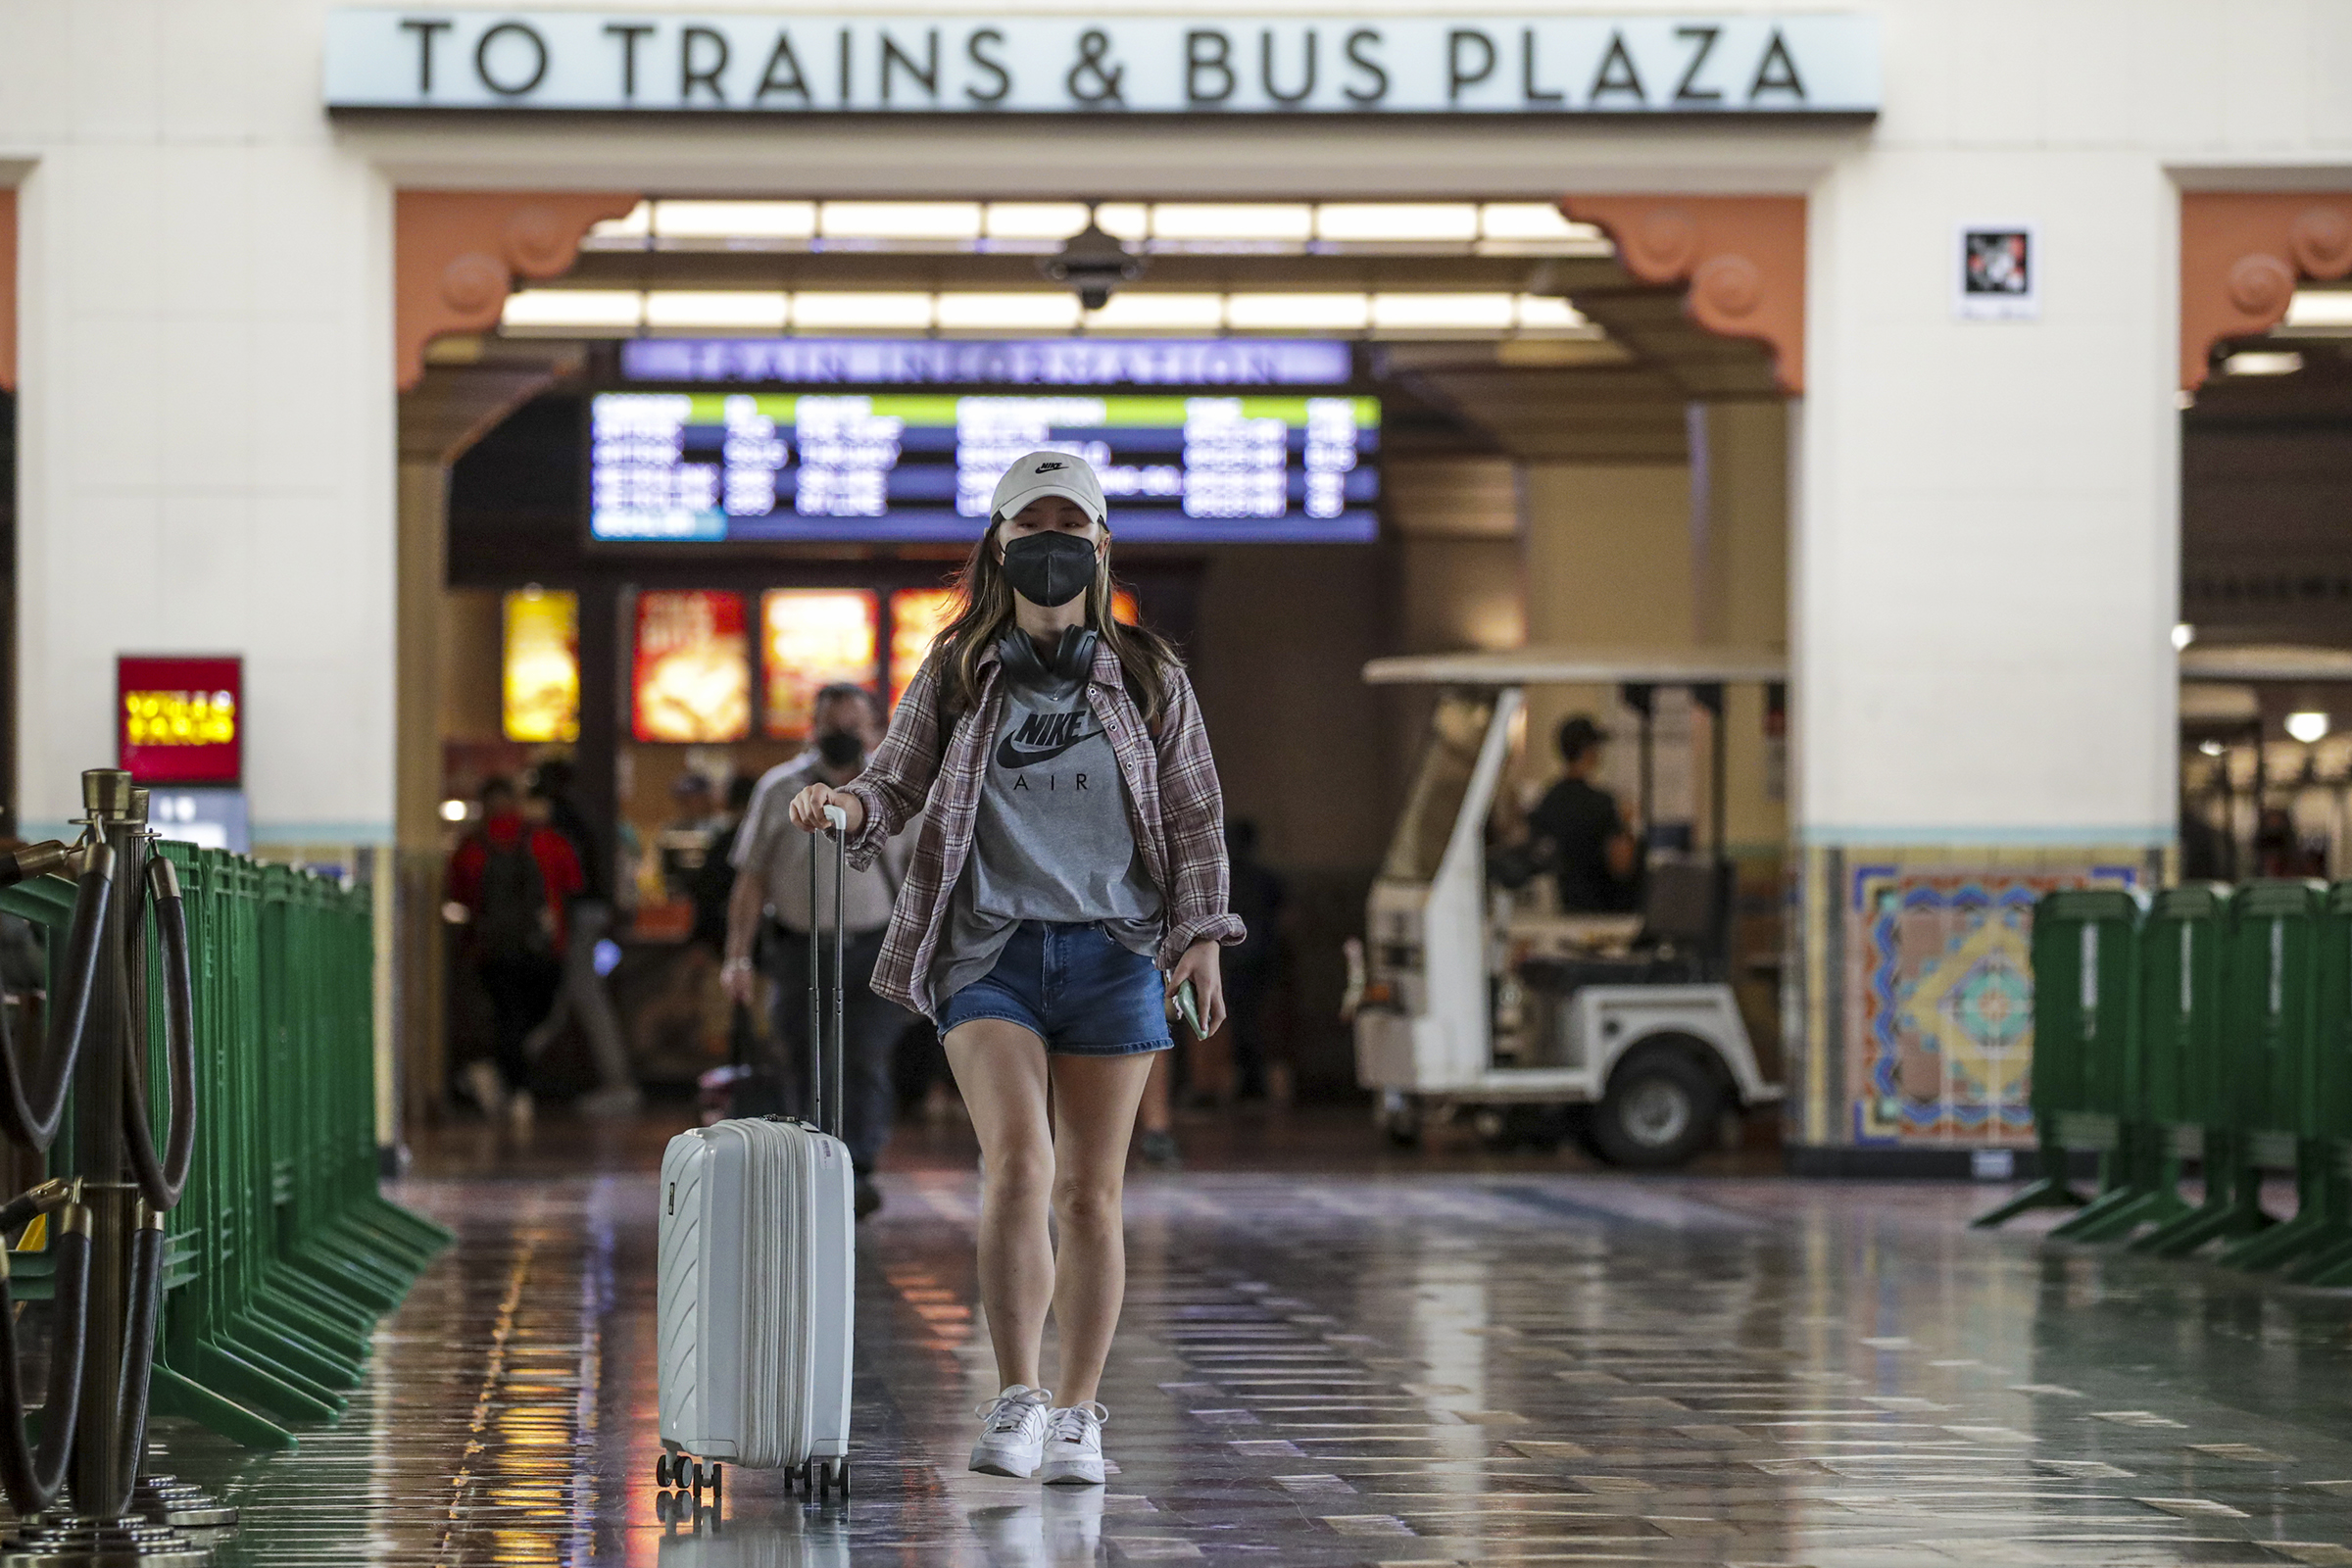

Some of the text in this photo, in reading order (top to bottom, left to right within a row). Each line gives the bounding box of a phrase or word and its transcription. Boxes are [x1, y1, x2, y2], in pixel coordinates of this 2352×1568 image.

[399, 21, 1806, 105] TO TRAINS & BUS PLAZA
[1013, 710, 1087, 747] NIKE
[1013, 773, 1088, 791] AIR
